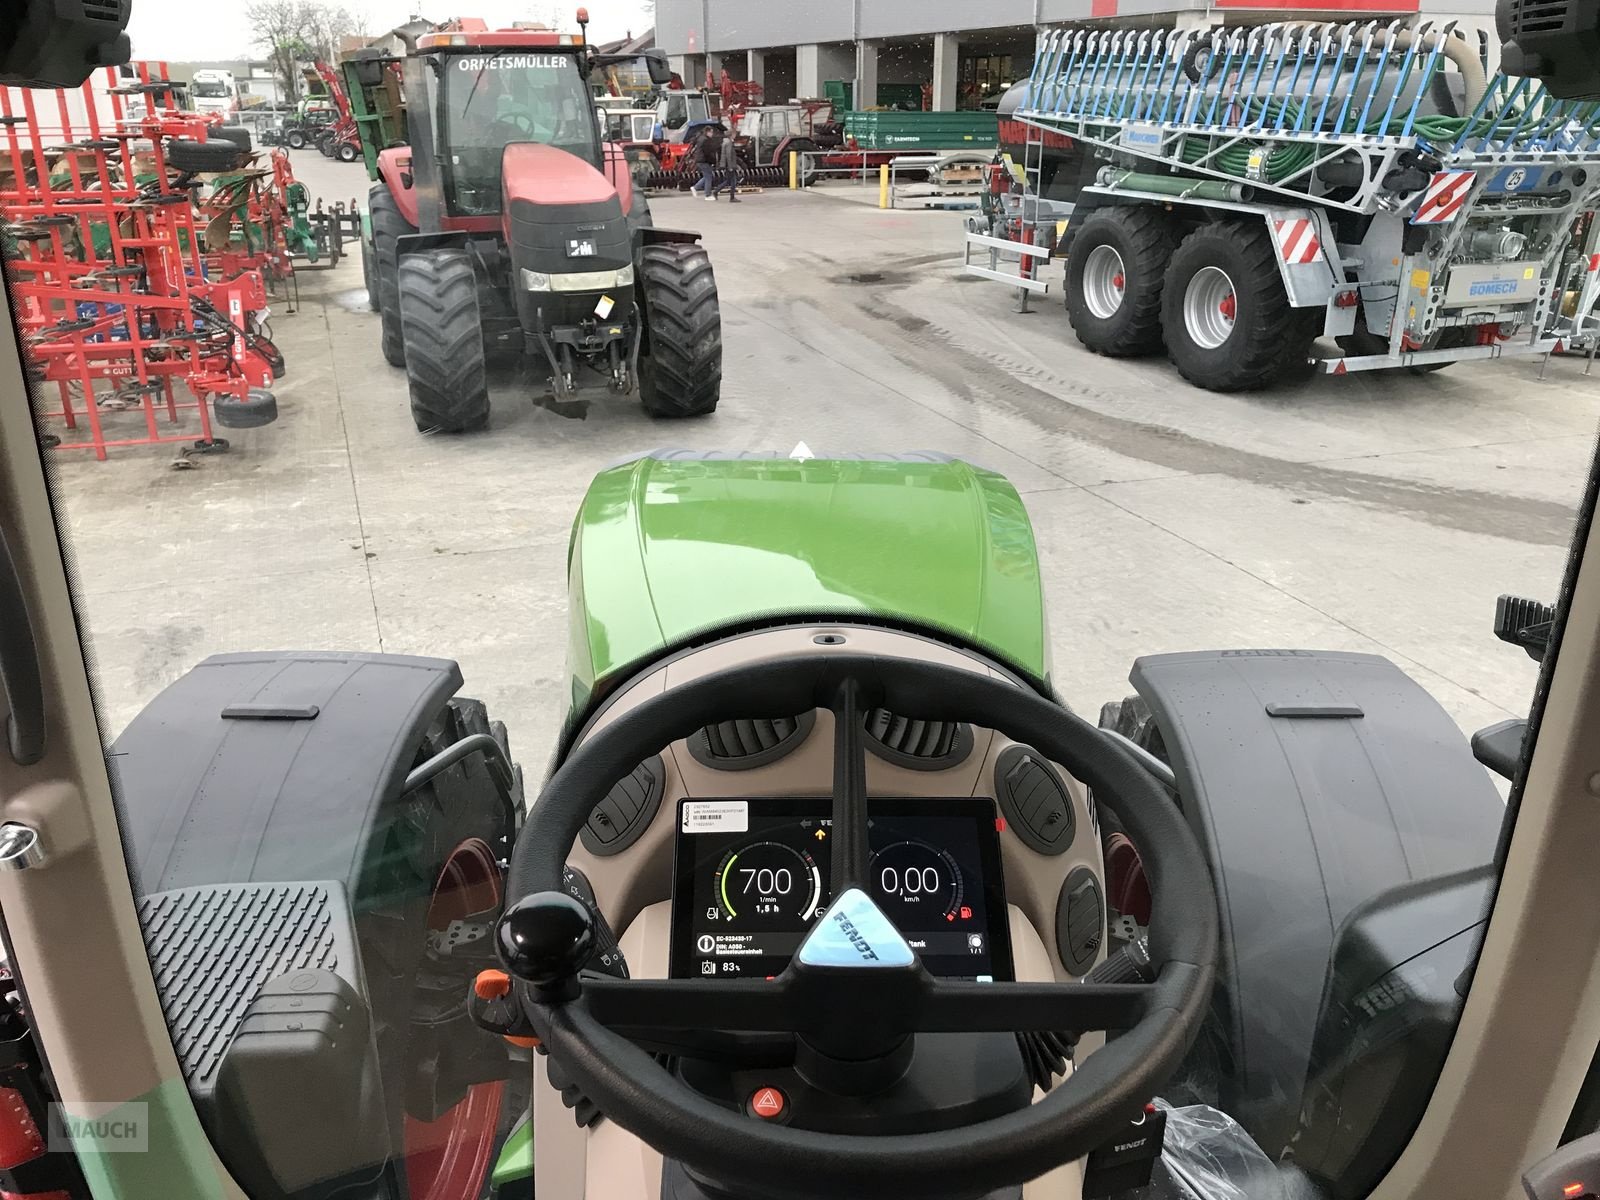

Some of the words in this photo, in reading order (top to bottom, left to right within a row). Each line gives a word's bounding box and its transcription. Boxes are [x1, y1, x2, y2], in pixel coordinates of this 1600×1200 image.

[458, 55, 567, 71] ORNETSMÜLLER
[1508, 171, 1524, 187] 25
[1469, 282, 1518, 296] BOMECH
[740, 868, 791, 894] 700
[881, 867, 939, 896] 0,00
[832, 911, 879, 961] FENDT
[908, 940, 926, 948] tank
[1114, 1137, 1147, 1152] FENDT
